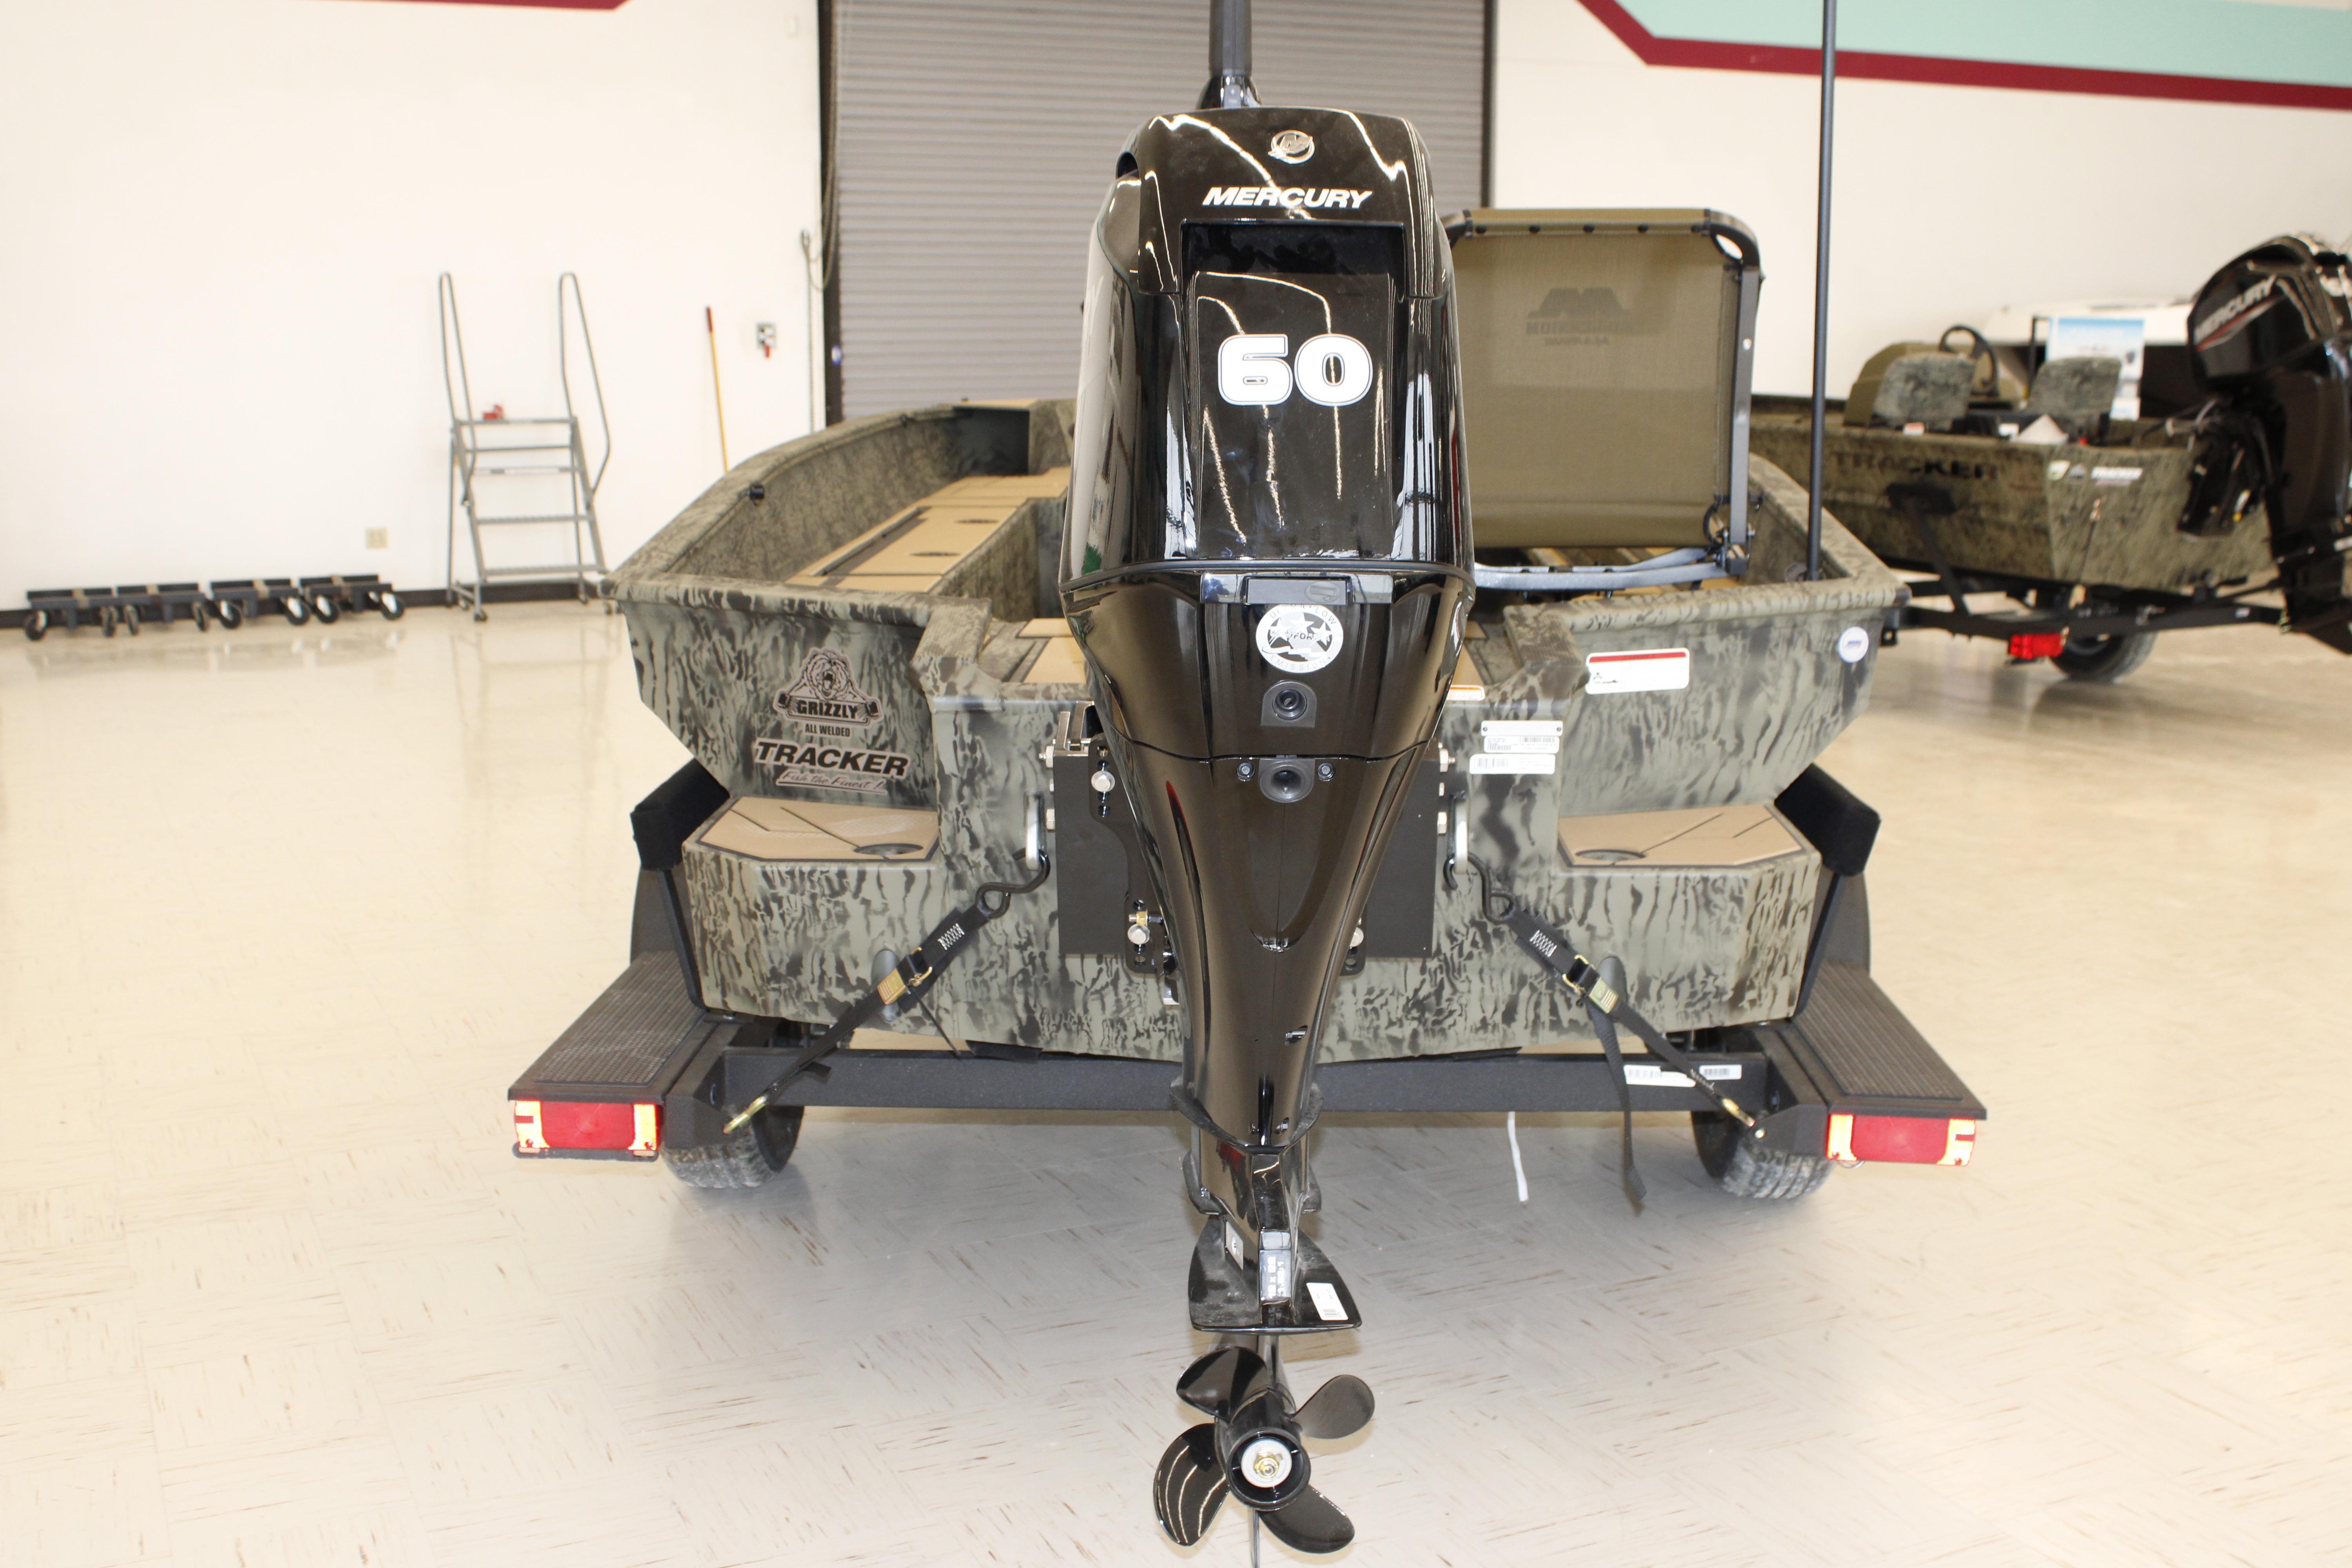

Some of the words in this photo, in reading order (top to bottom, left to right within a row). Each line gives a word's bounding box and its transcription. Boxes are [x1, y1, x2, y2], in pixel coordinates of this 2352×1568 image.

[1202, 187, 1373, 209] MERCURY
[1218, 334, 1373, 407] 60
[1315, 606, 1337, 624] LOW
[1270, 655, 1327, 671] EMISSION
[797, 701, 858, 719] GRIZZLY
[805, 724, 817, 734] ALL
[820, 725, 850, 737] WELDED
[757, 741, 908, 776] TRACKER
